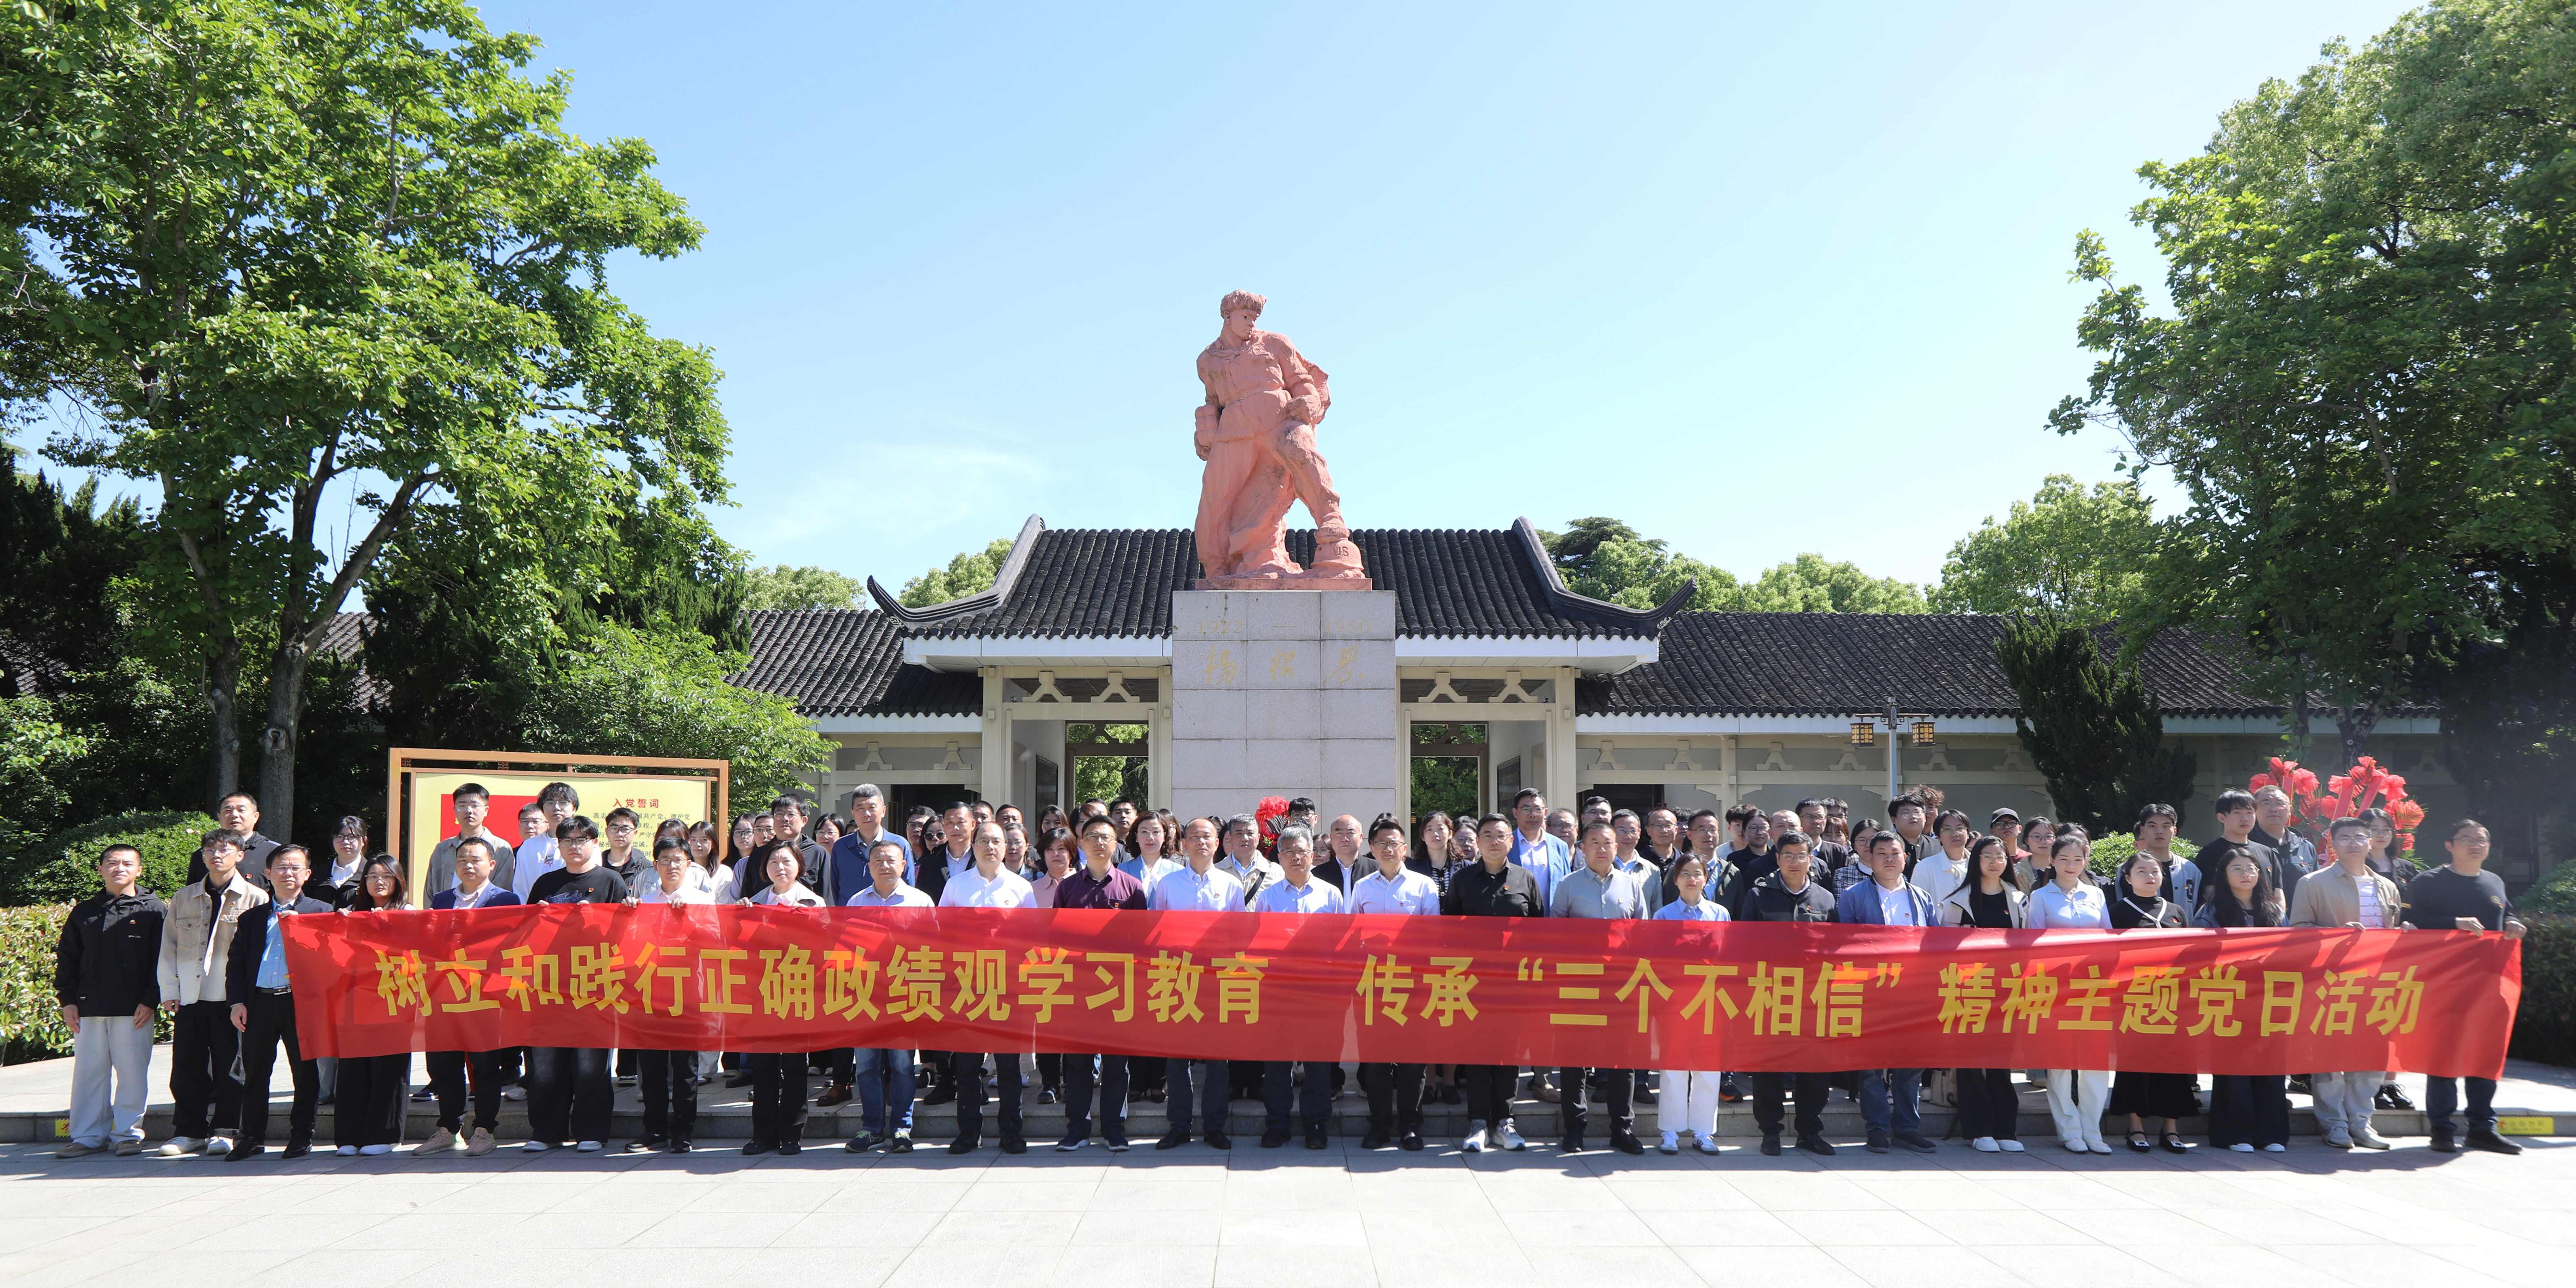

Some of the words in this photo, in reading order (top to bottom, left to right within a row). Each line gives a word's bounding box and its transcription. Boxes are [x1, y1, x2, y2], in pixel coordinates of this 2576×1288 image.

[1334, 546, 1349, 556] US
[1197, 621, 1243, 634] 1922
[1324, 620, 1370, 633] 1950
[613, 798, 659, 808] 入党誓词
[375, 941, 1268, 1024] 树立和践行正确政绩观学习教育
